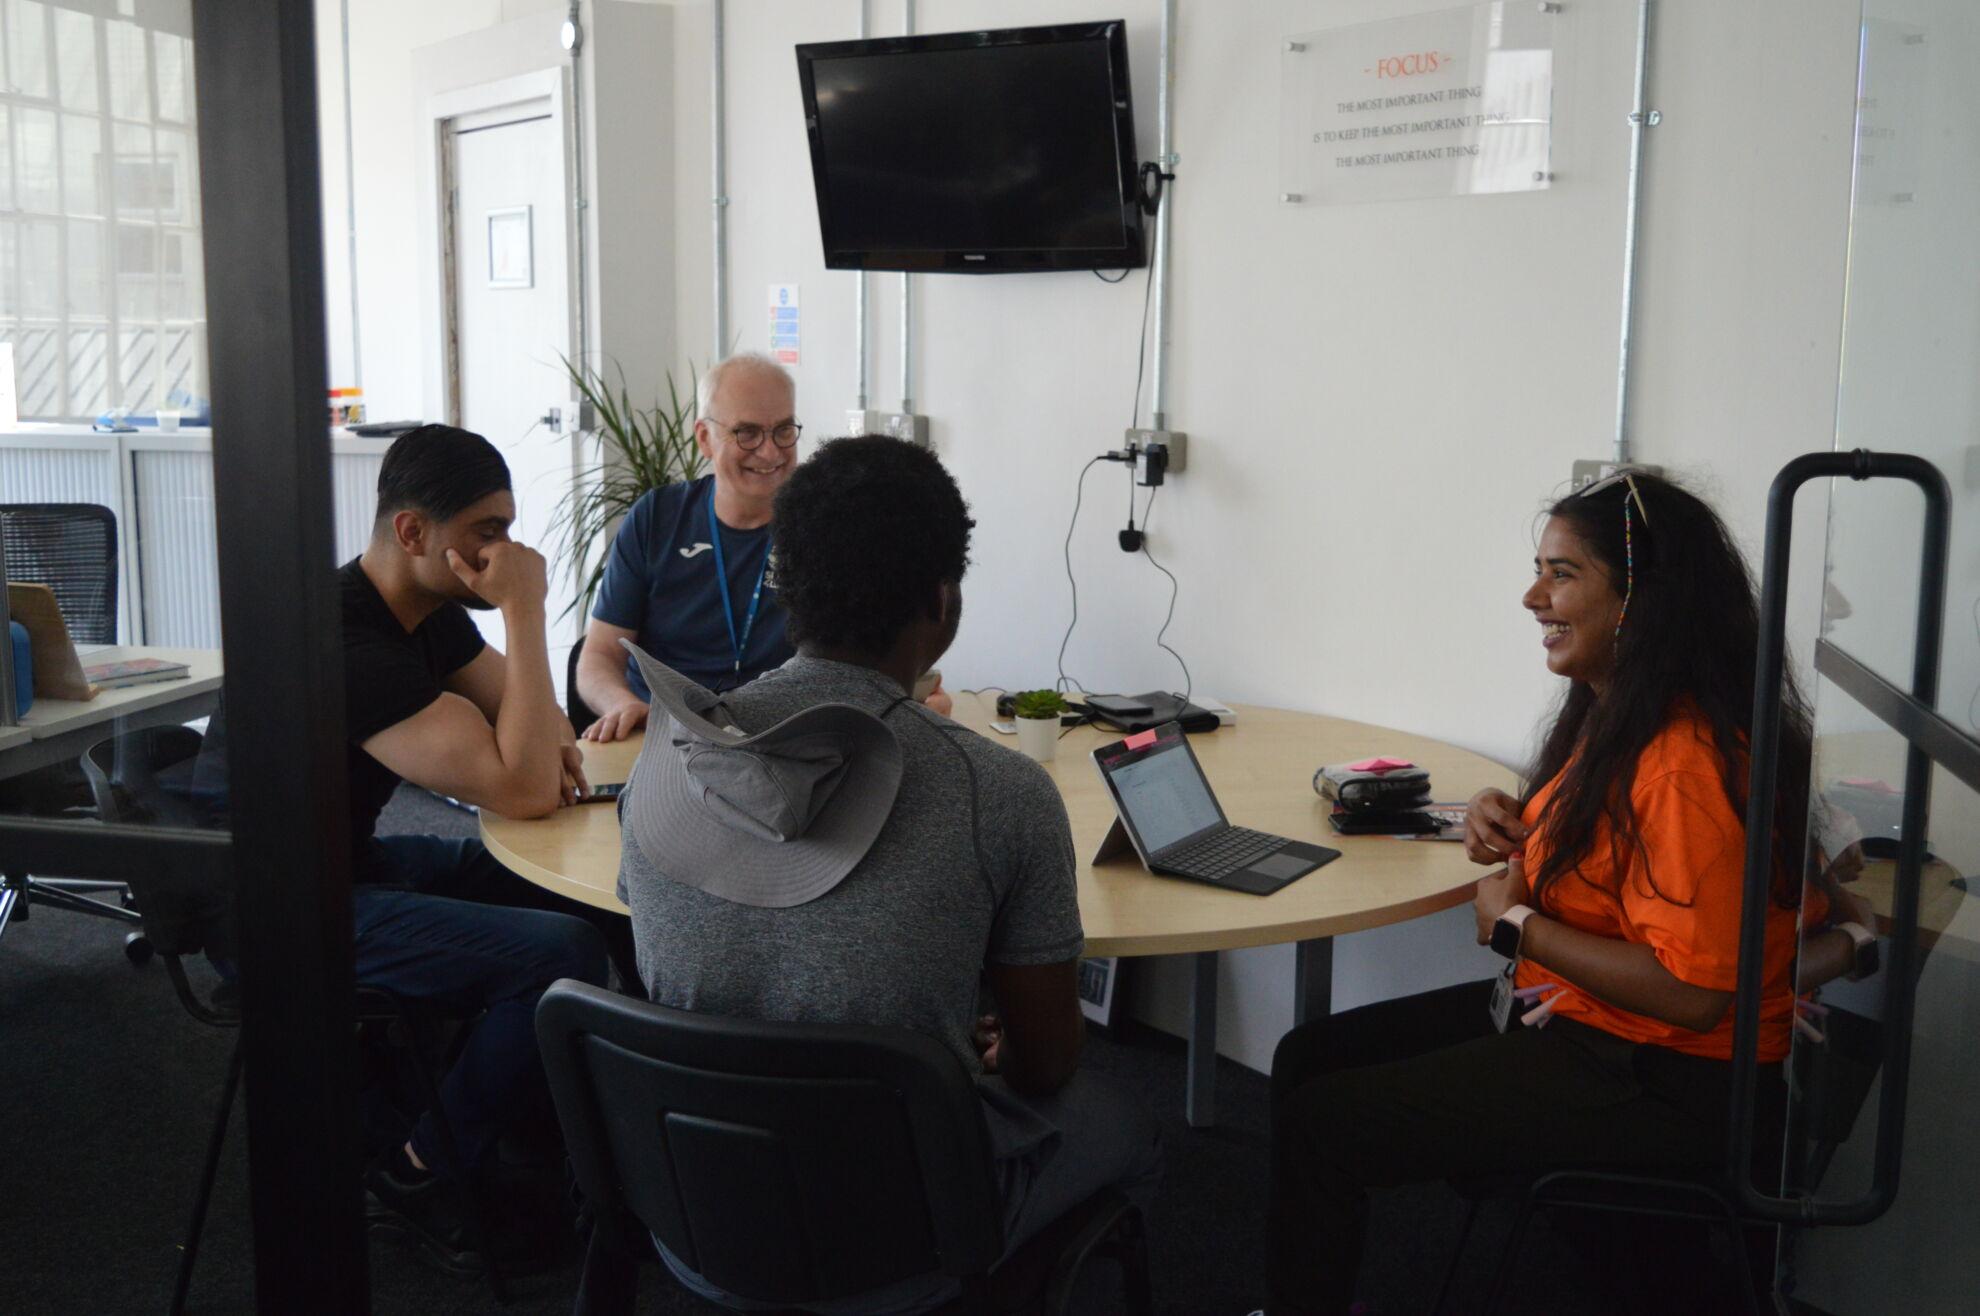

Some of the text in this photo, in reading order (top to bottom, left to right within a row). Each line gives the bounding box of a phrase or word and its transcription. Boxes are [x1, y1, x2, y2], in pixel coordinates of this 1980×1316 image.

[1377, 51, 1438, 79] FOCUS
[1336, 86, 1482, 114] THE MOST IMPORTANT THING
[1323, 130, 1337, 142] TO
[1338, 128, 1359, 141] KEEP
[1362, 126, 1380, 139] THE
[1381, 122, 1409, 136] MOST
[1411, 115, 1472, 134] IMPORTANT
[1336, 143, 1480, 168] THE MOST IMPORTANT THING
